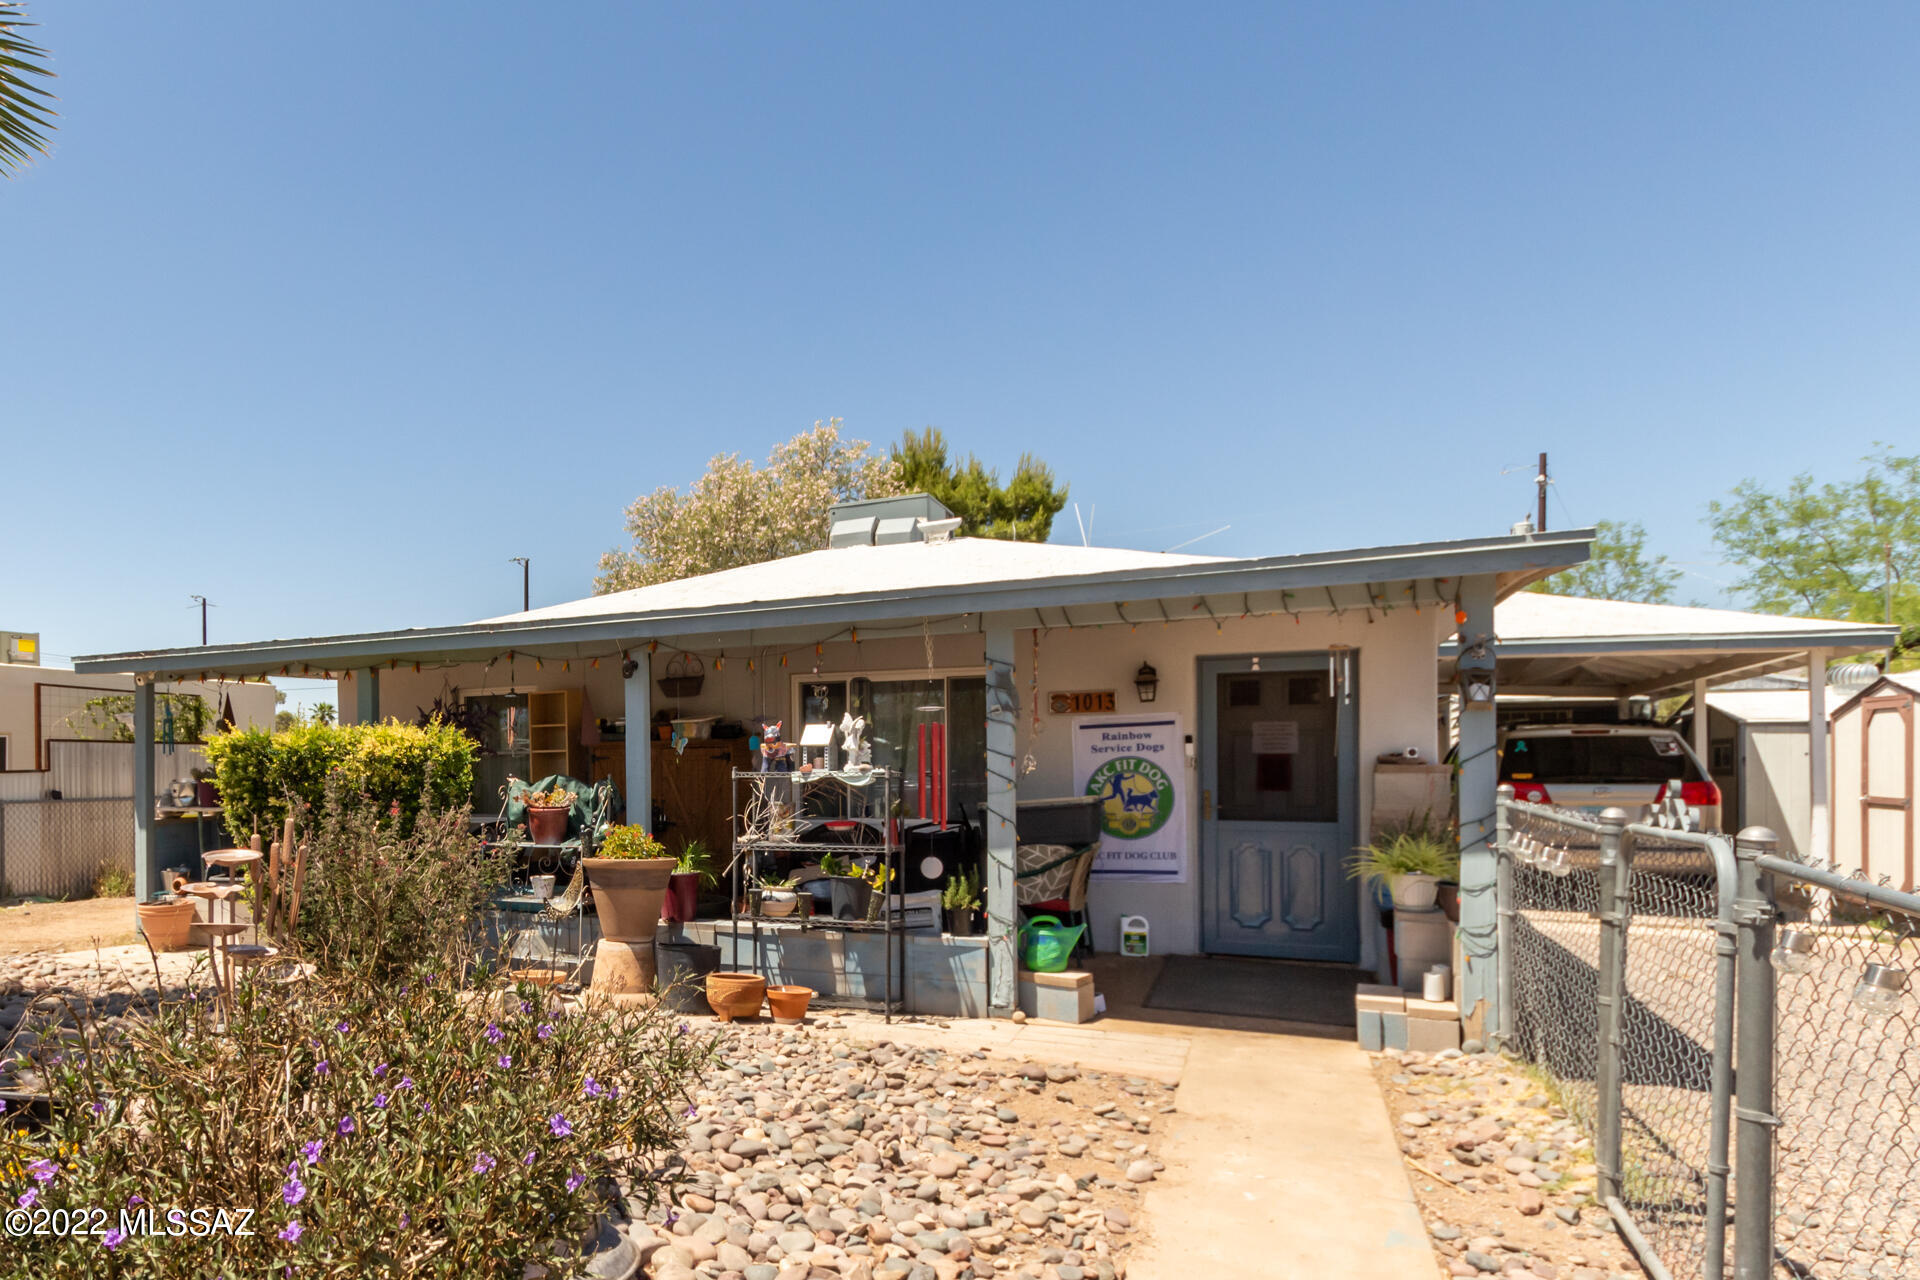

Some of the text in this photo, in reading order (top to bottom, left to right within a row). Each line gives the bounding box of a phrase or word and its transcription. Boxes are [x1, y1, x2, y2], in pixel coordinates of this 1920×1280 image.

[1075, 693, 1115, 711] 1013
[1102, 731, 1152, 741] Rainbow
[1091, 743, 1164, 753] Service Dogs
[1090, 759, 1168, 793] AKC FIT DOG
[1106, 851, 1122, 860] FIT
[1125, 851, 1148, 860] DOG
[1150, 851, 1177, 860] CLUB
